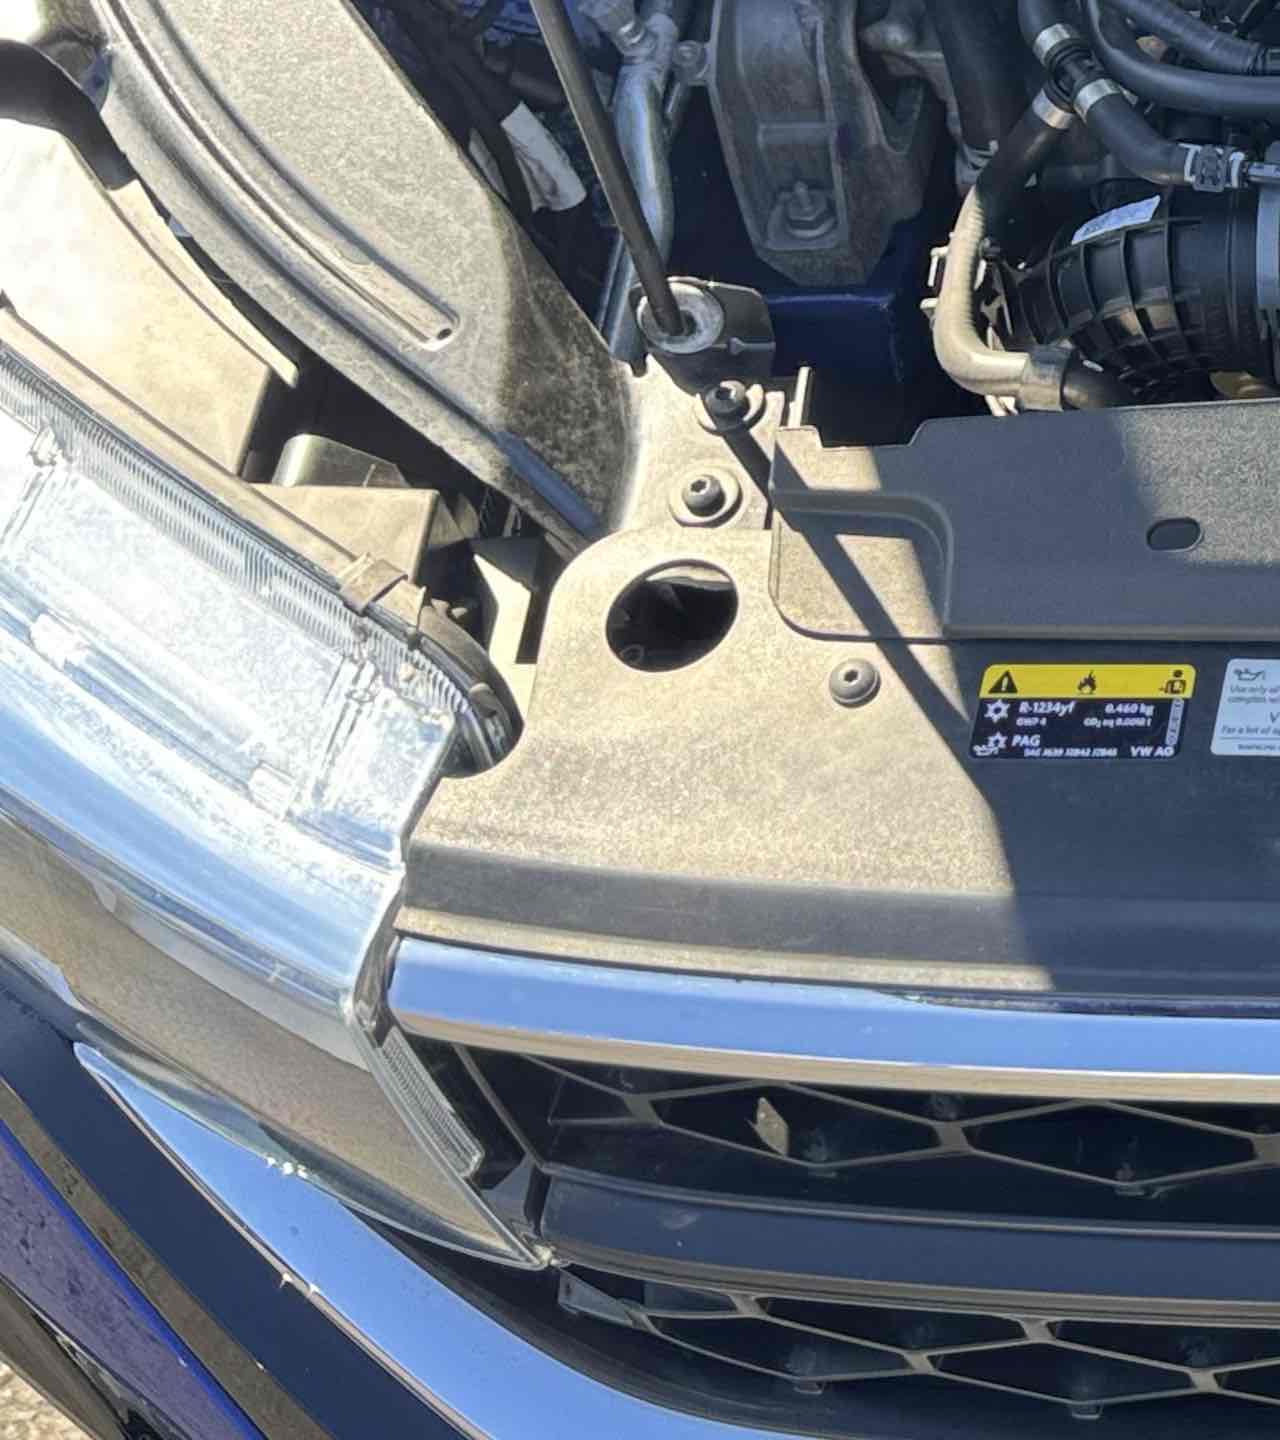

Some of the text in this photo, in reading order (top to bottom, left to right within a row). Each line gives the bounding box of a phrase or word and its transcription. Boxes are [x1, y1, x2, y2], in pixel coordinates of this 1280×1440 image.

[1018, 700, 1075, 717] R-1234yf
[1139, 703, 1155, 717] kg
[1011, 734, 1041, 747] PAG
[1130, 746, 1153, 758] VW
[1155, 746, 1175, 758] AG
